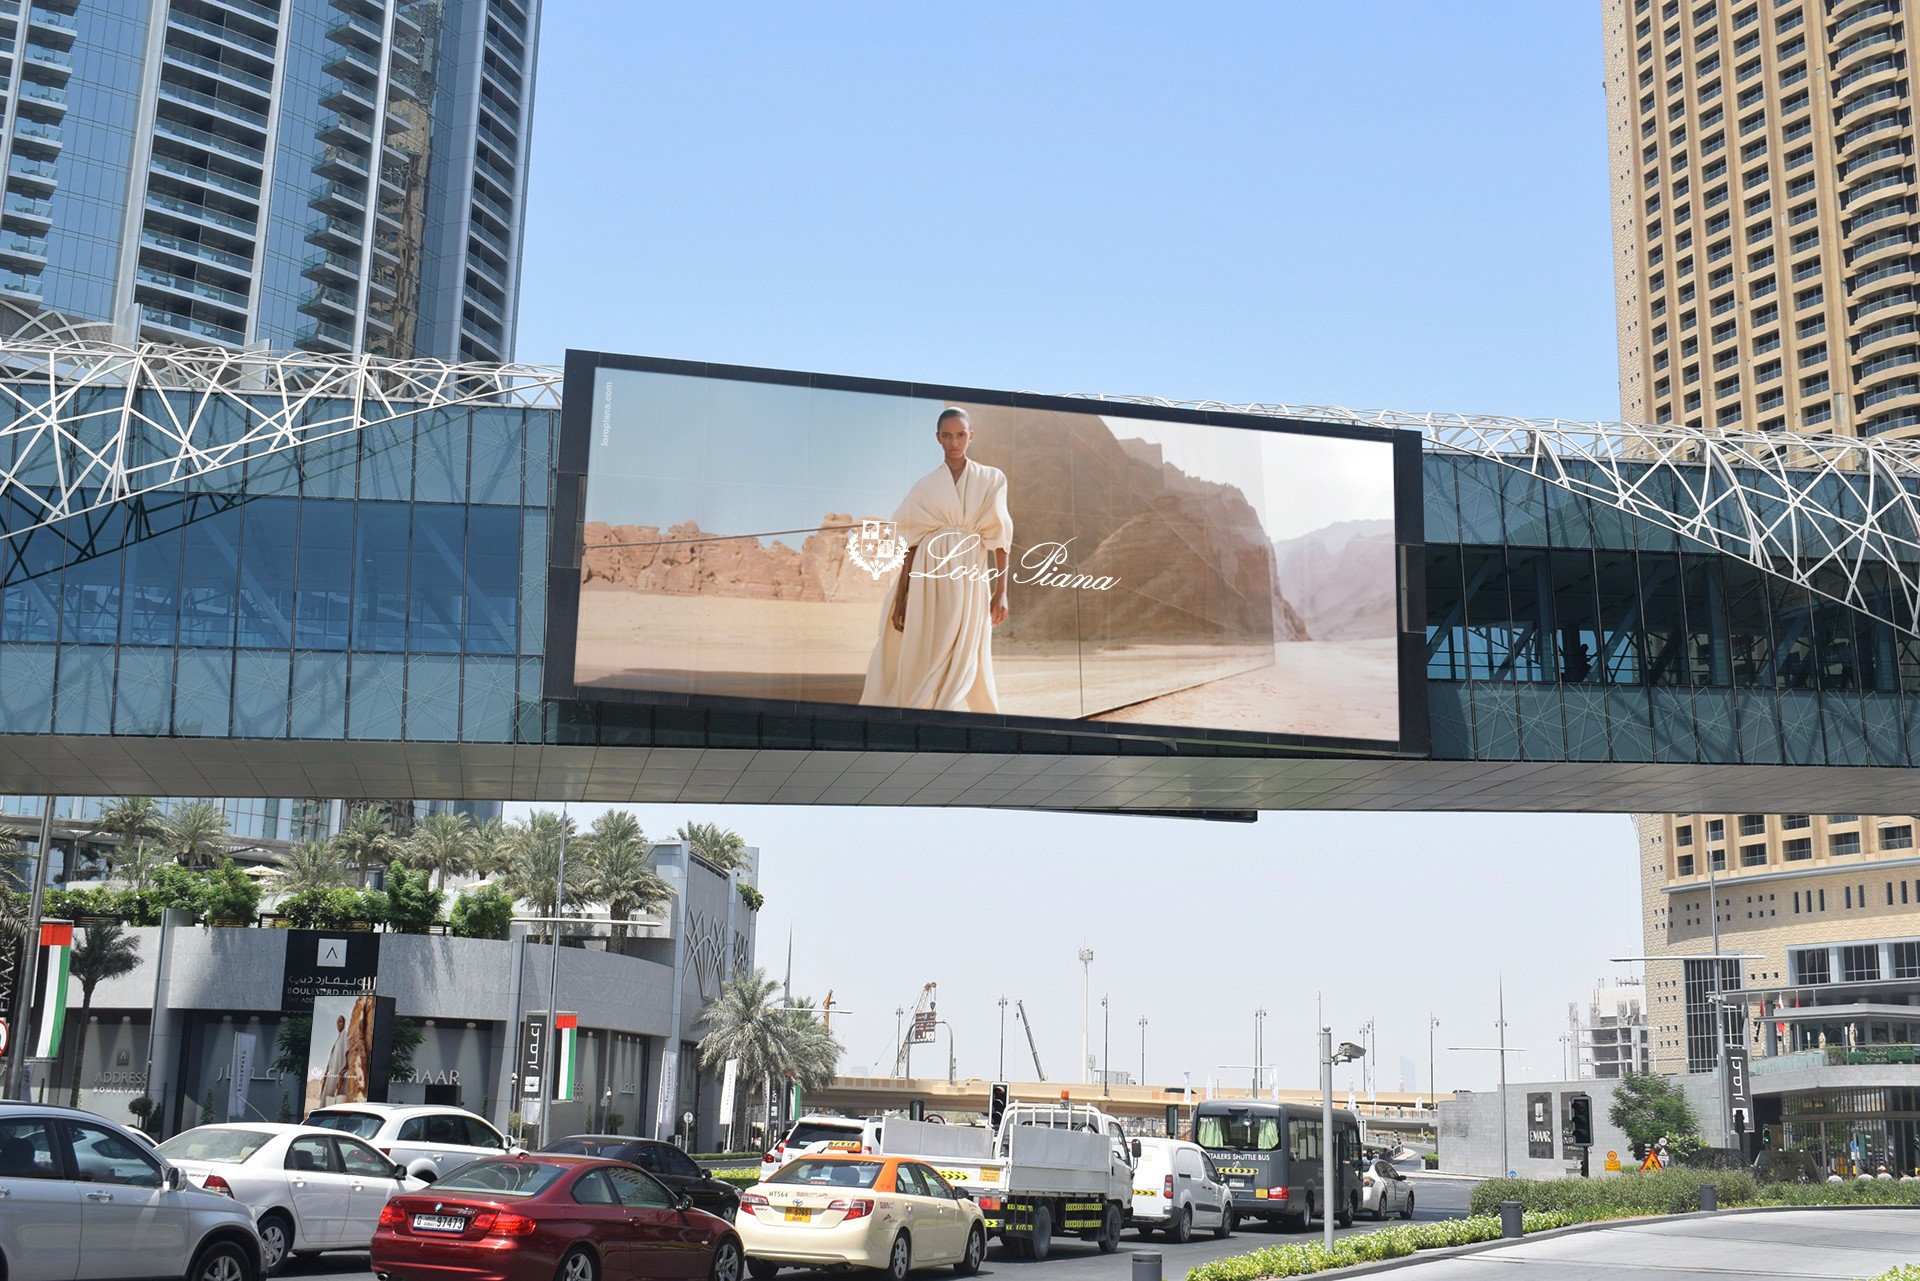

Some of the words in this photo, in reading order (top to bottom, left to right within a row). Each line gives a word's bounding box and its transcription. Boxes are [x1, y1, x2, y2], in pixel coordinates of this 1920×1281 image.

[600, 382, 612, 446] loropiana.com
[908, 531, 1009, 583] Loro
[1012, 536, 1121, 591] Piana
[1529, 1130, 1552, 1143] EMAAR
[436, 1216, 463, 1229] 97473
